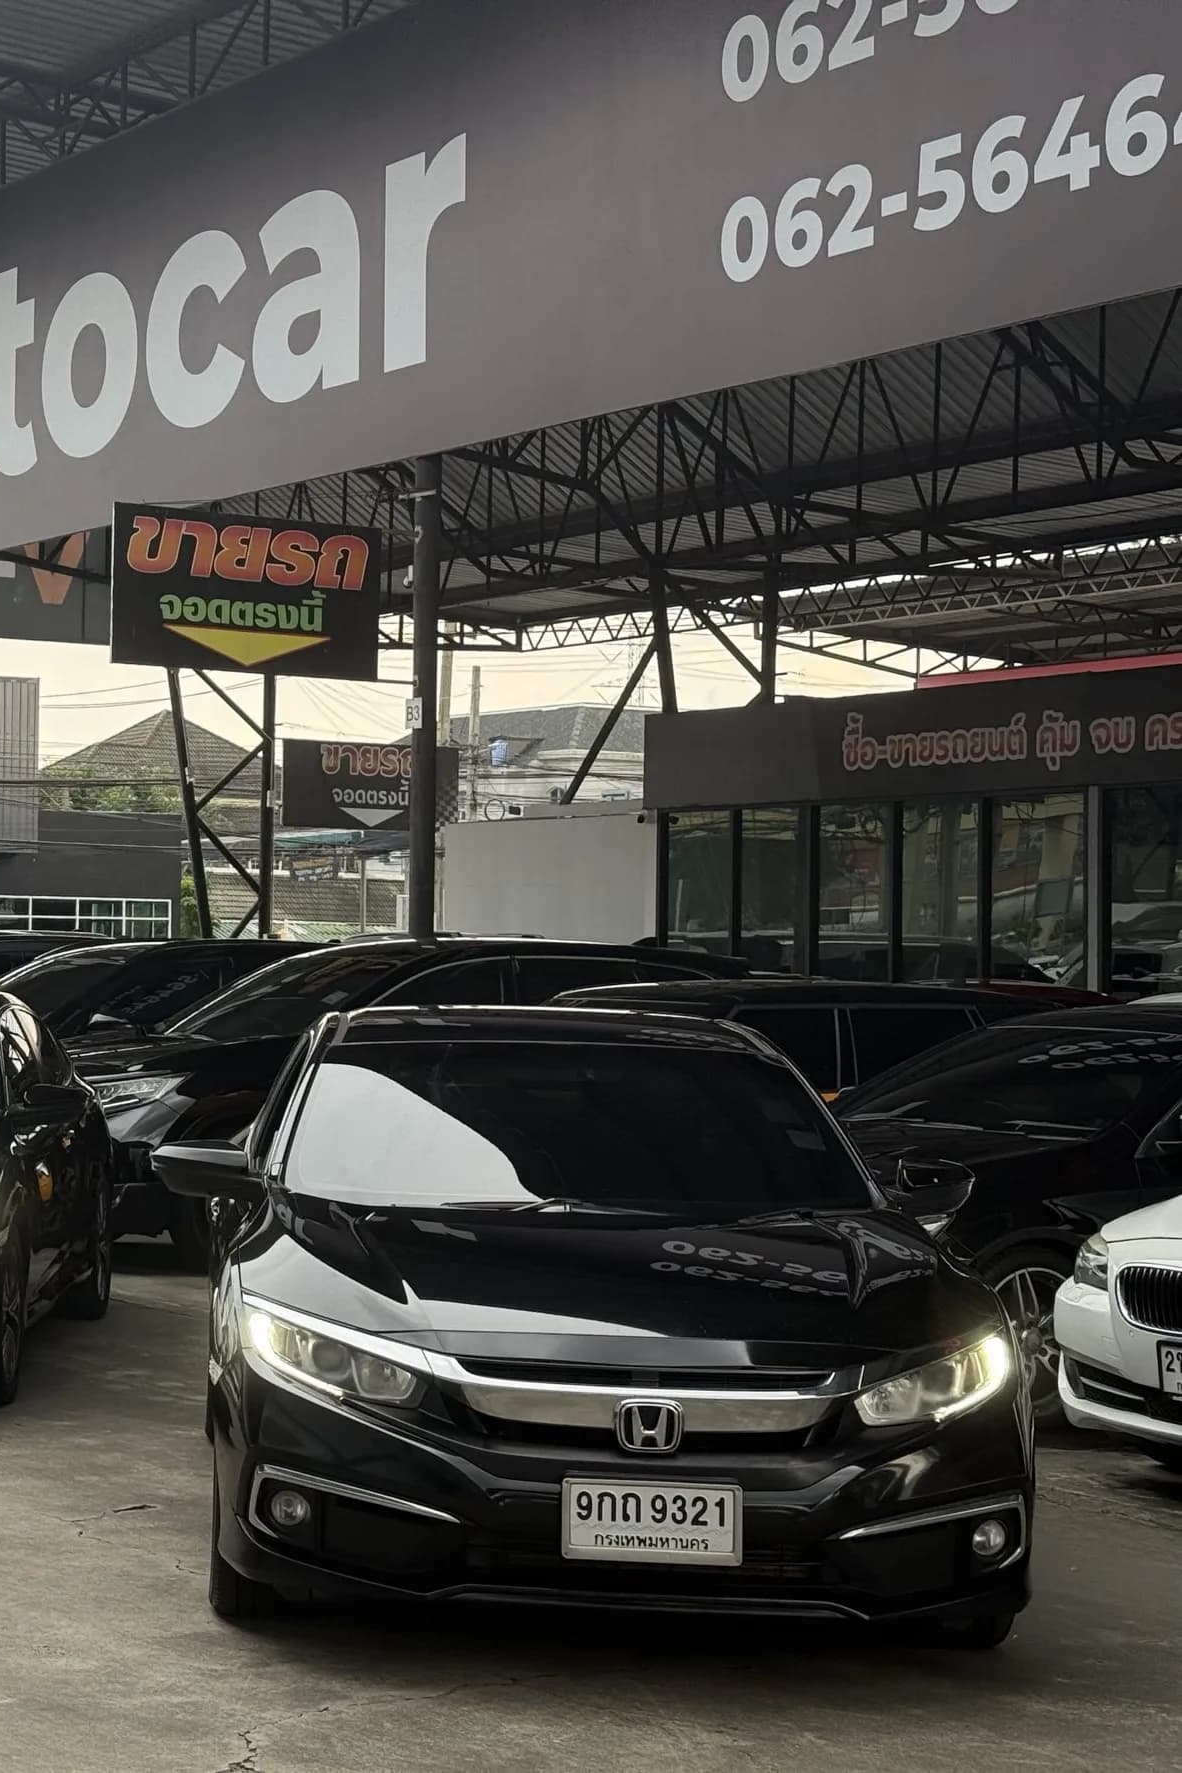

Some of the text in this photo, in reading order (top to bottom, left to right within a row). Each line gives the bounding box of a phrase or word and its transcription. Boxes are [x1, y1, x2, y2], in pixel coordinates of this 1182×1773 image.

[721, 0, 1019, 102] 062-
[720, 73, 1182, 282] 062-5646
[126, 515, 370, 591] ขายรถ
[159, 590, 326, 632] จอดตรงนี้
[406, 705, 420, 721] B3
[1036, 710, 1081, 771] คุ้ม
[1089, 716, 1136, 754] จบ
[331, 779, 409, 806] จอดตรงนี้
[576, 1490, 726, 1527] 9กถ 9321
